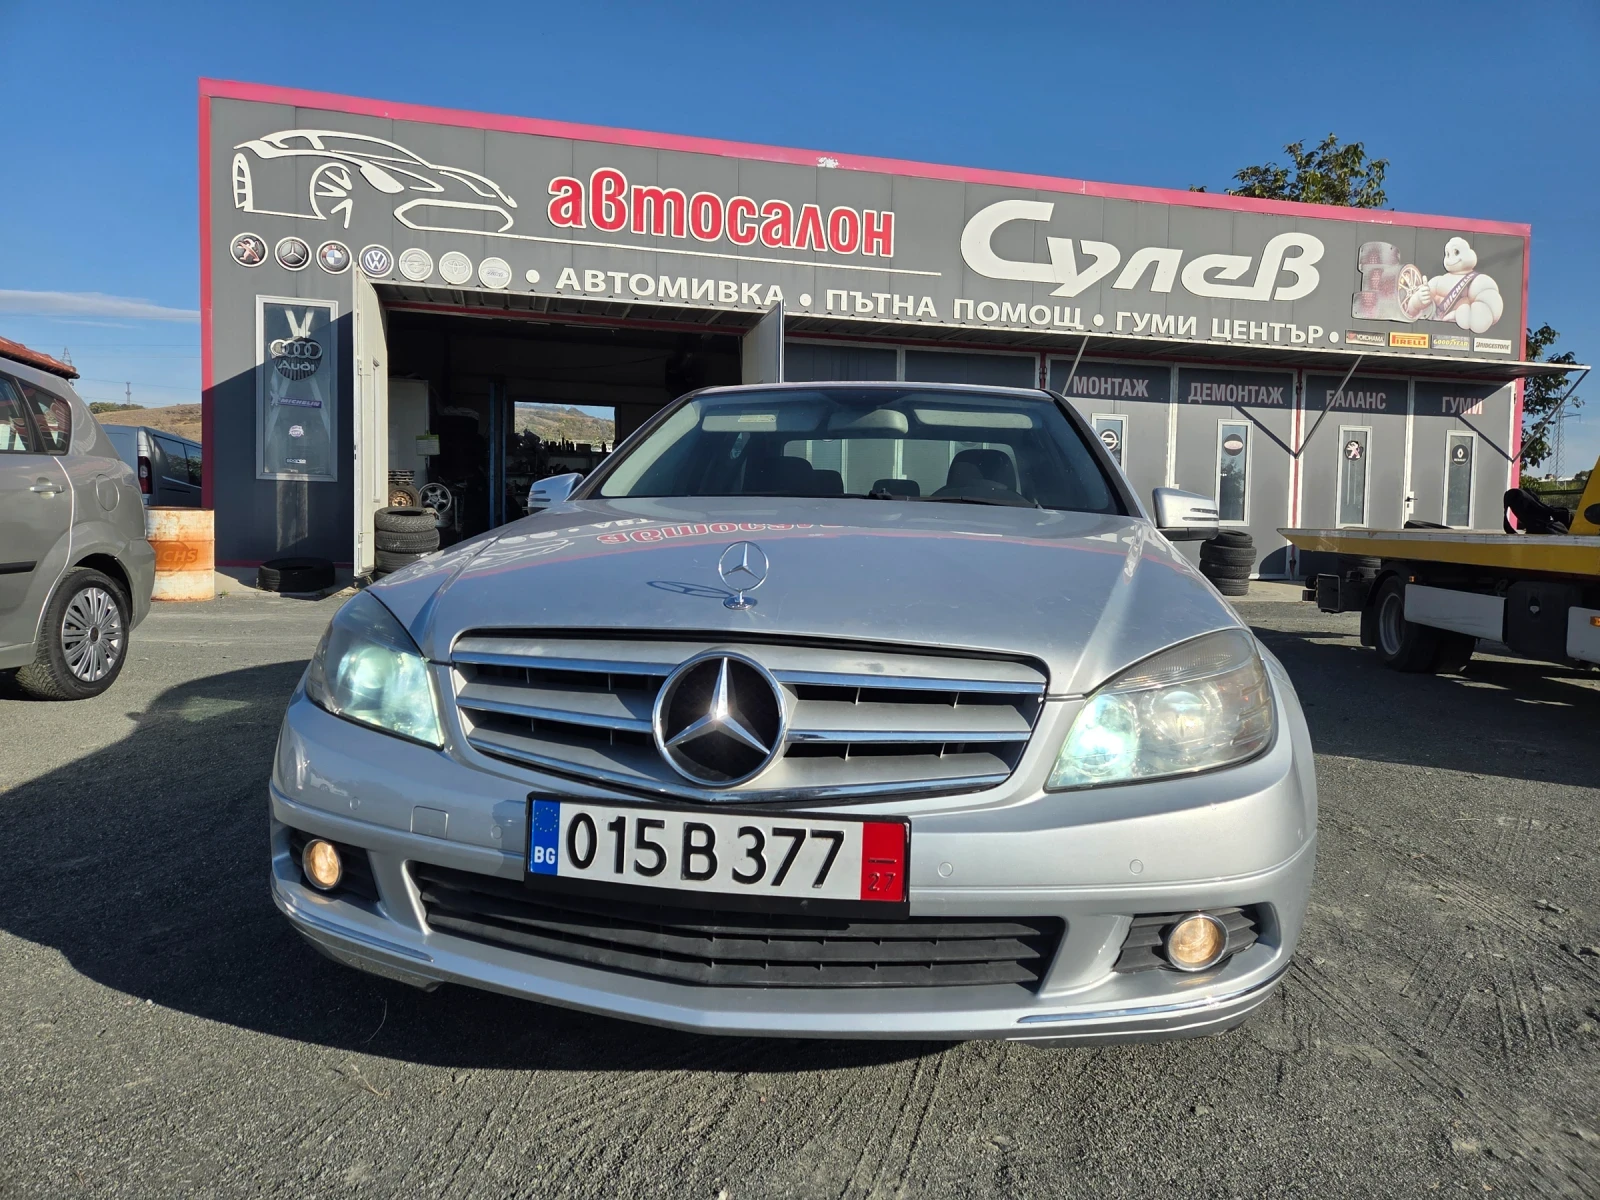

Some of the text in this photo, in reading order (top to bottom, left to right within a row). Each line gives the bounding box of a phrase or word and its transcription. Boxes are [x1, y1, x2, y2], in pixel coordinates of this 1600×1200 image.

[548, 168, 895, 258] автосалон
[960, 199, 1325, 302] Сулев
[556, 267, 1323, 344] АВТОМИВКА ПЪТНА ПОМОЩ ГУМИ ЦЕНТЪР
[1391, 334, 1426, 346] PIRELLI
[278, 360, 315, 371] Audi
[1072, 375, 1150, 398] МОНТАЖ
[1188, 382, 1284, 404] ДЕМОНТАЖ
[280, 398, 321, 407] MICHELIN
[1442, 396, 1483, 415] ГУМИ
[156, 549, 197, 562] CHS
[533, 845, 556, 865] BG
[868, 871, 897, 891] 27
